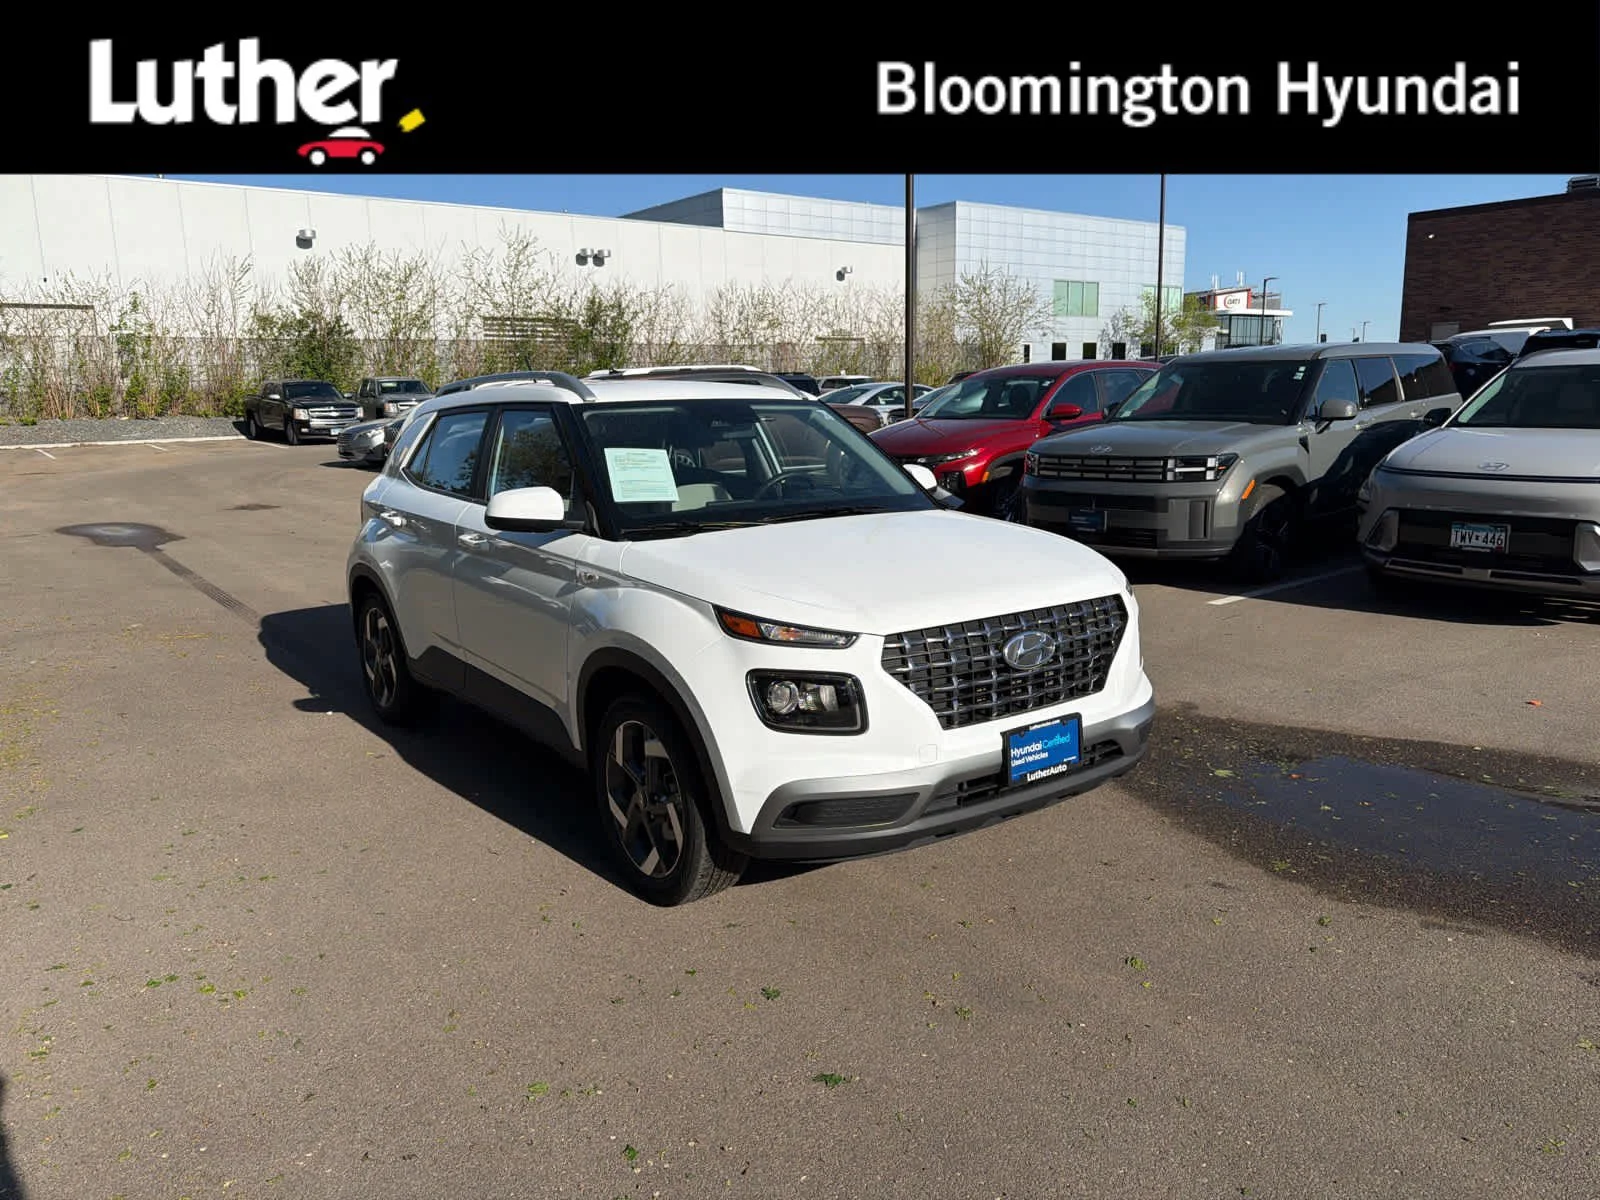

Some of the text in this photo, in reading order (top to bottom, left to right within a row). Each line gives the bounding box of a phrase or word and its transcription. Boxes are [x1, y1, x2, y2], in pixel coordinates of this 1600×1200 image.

[1011, 752, 1048, 767] Used Vehicles
[1027, 764, 1067, 781] LutherAuto
